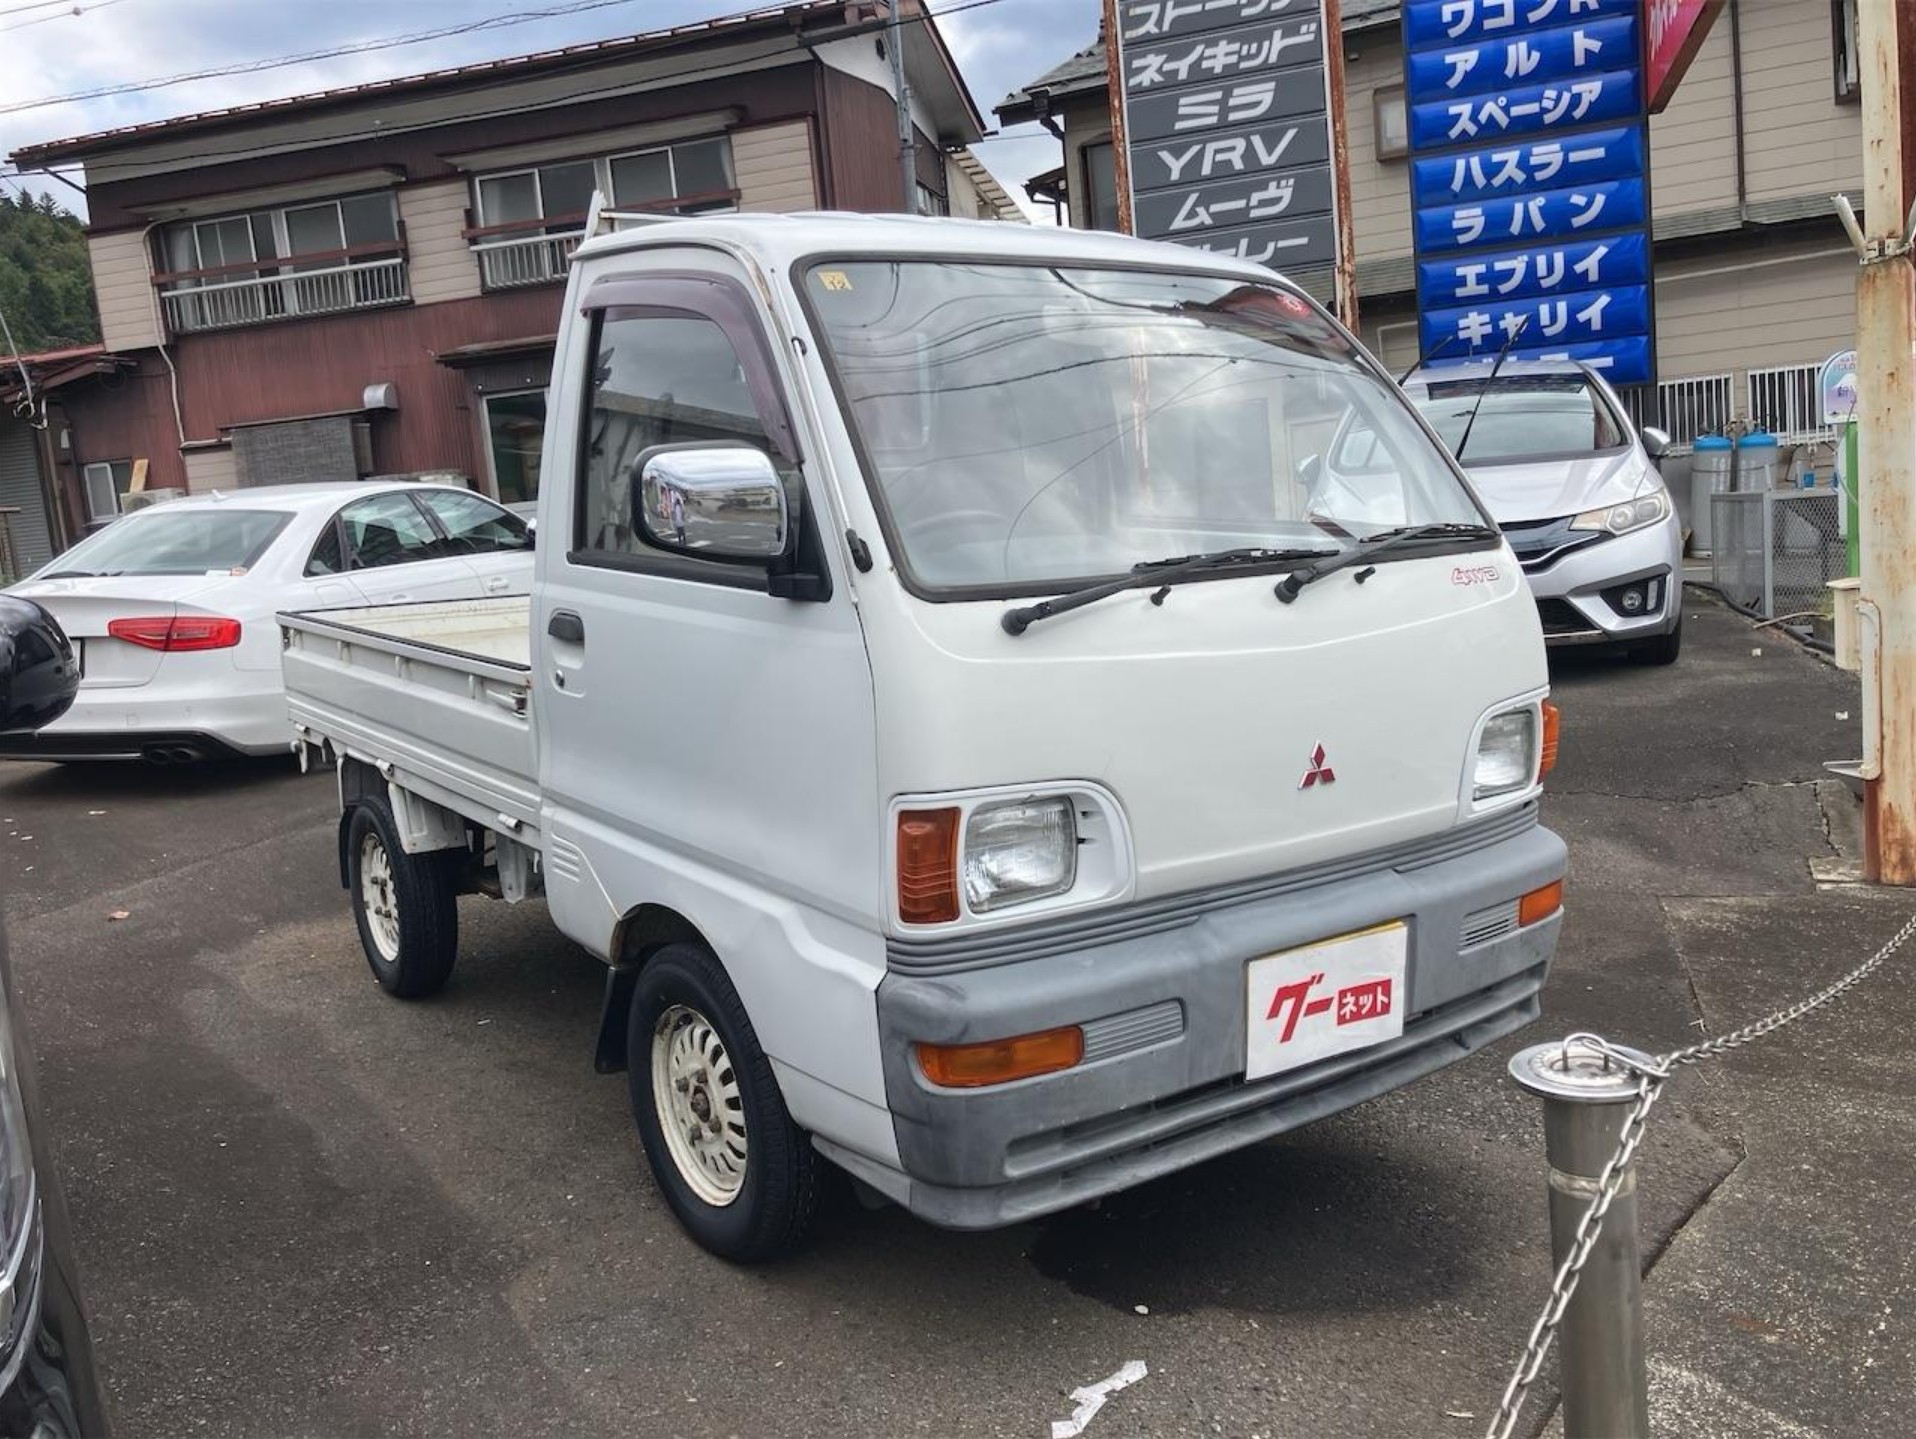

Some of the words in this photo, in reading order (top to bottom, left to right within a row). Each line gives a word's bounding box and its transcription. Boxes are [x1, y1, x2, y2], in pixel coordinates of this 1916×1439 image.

[1128, 22, 1318, 88] ネイキッド
[1444, 29, 1602, 89] アルト
[1174, 81, 1276, 130] ミラ
[1448, 80, 1603, 140] スペーシア
[1157, 128, 1299, 181] YRV
[1451, 144, 1606, 193] ハスラー
[1169, 178, 1295, 231] ムーヴ
[1452, 192, 1607, 244] ラパン
[1455, 245, 1609, 298] エブリイ
[1458, 294, 1612, 346] キャリイ
[1451, 566, 1500, 586] 4WD
